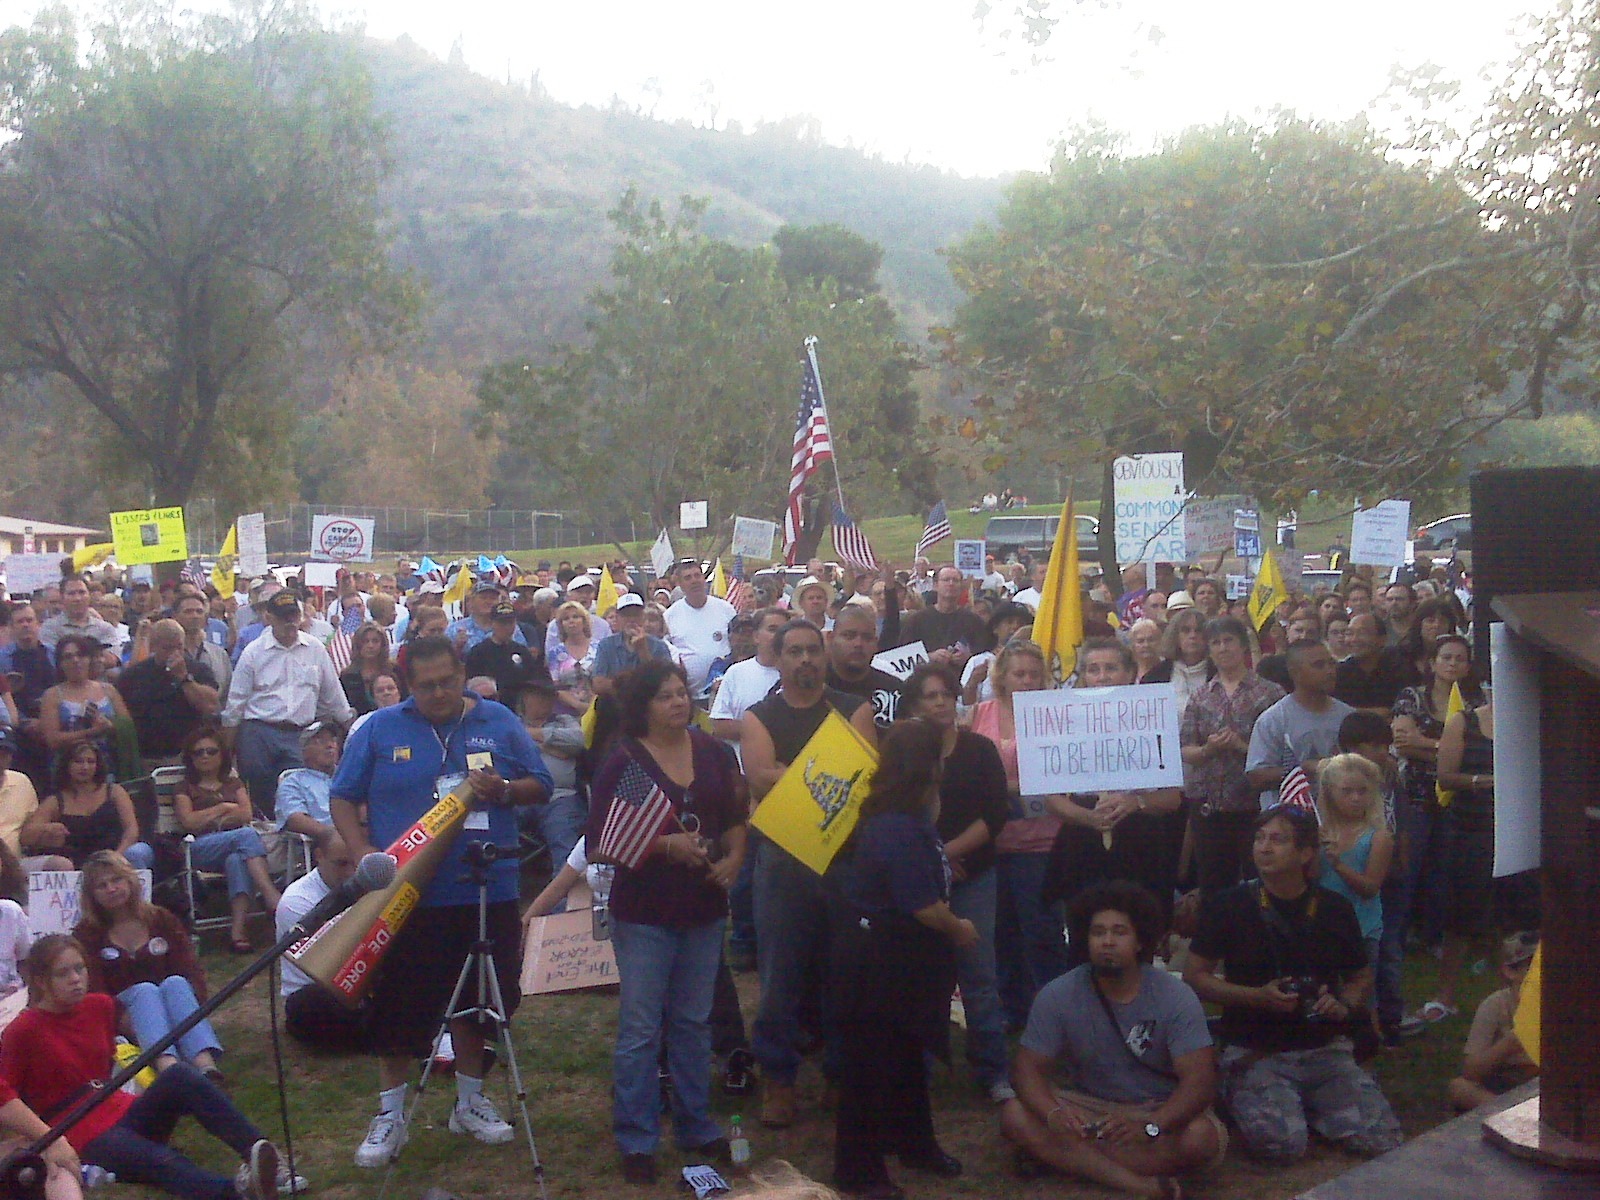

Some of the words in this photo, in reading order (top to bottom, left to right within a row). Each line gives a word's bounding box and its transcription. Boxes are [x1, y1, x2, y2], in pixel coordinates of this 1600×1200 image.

[1113, 459, 1182, 480] OBVIOUSLY
[1115, 500, 1184, 518] COMMON
[1118, 520, 1181, 540] SENSE
[1117, 540, 1185, 562] CZAR
[1023, 706, 1028, 738] I
[1033, 703, 1076, 737] HAVE
[1081, 701, 1113, 734] THE
[1118, 697, 1168, 733] RIGHT
[1039, 745, 1062, 777] TO
[1067, 742, 1089, 775] BE
[44, 873, 67, 890] AM
[340, 959, 367, 994] ORE
